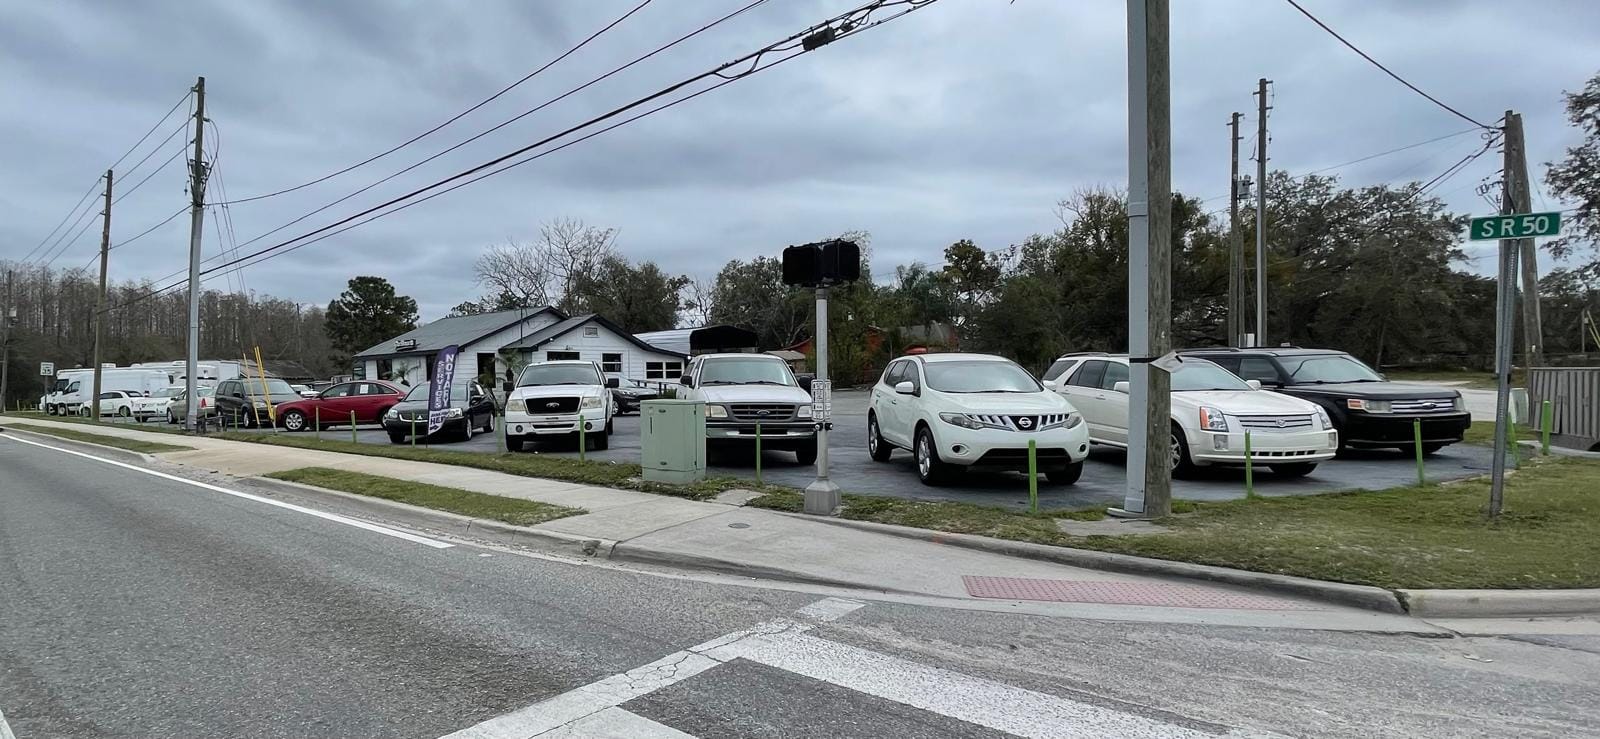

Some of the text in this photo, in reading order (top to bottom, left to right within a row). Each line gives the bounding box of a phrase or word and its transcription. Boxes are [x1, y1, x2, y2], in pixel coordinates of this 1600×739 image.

[1522, 216, 1549, 235] 50
[434, 361, 445, 409] SERVICES
[443, 354, 454, 407] NOTARY
